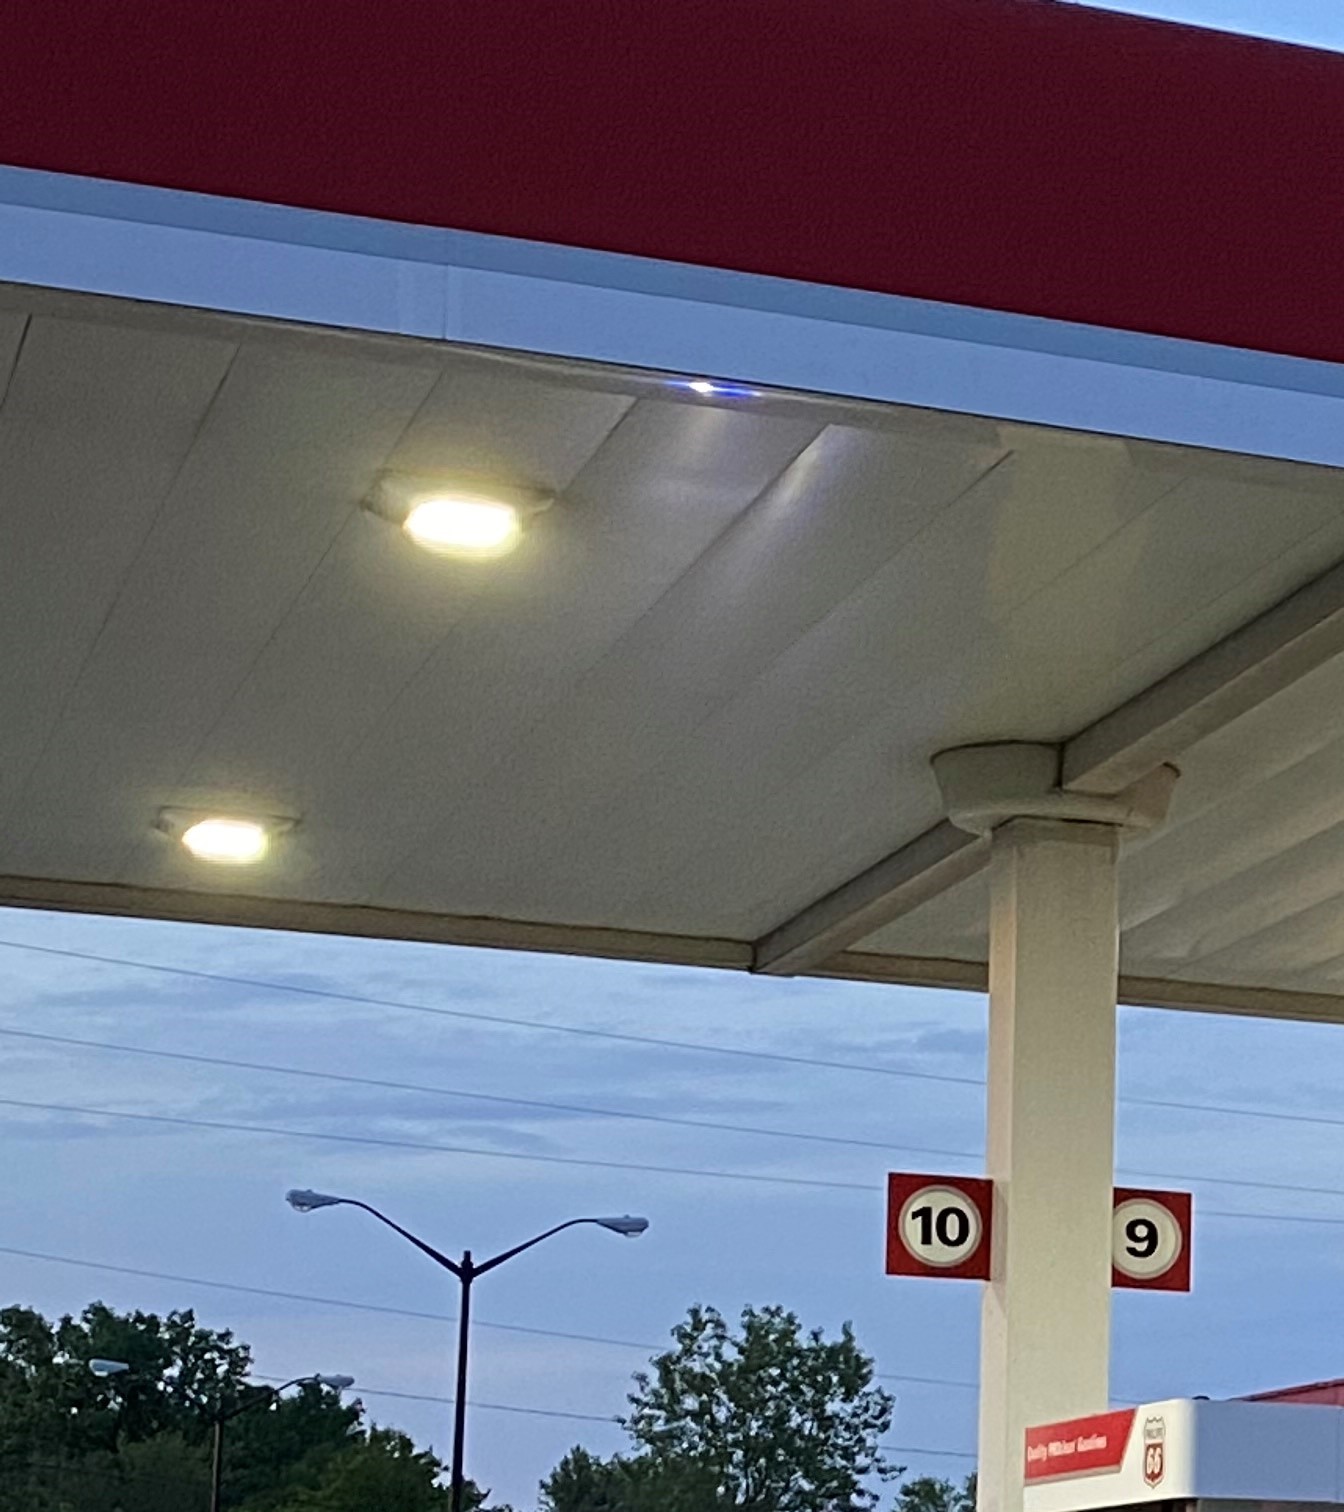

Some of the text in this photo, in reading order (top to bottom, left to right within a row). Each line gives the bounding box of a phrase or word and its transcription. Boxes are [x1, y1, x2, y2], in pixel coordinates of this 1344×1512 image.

[911, 1206, 970, 1247] 10
[1125, 1218, 1159, 1258] 9
[1146, 1447, 1162, 1475] 66
